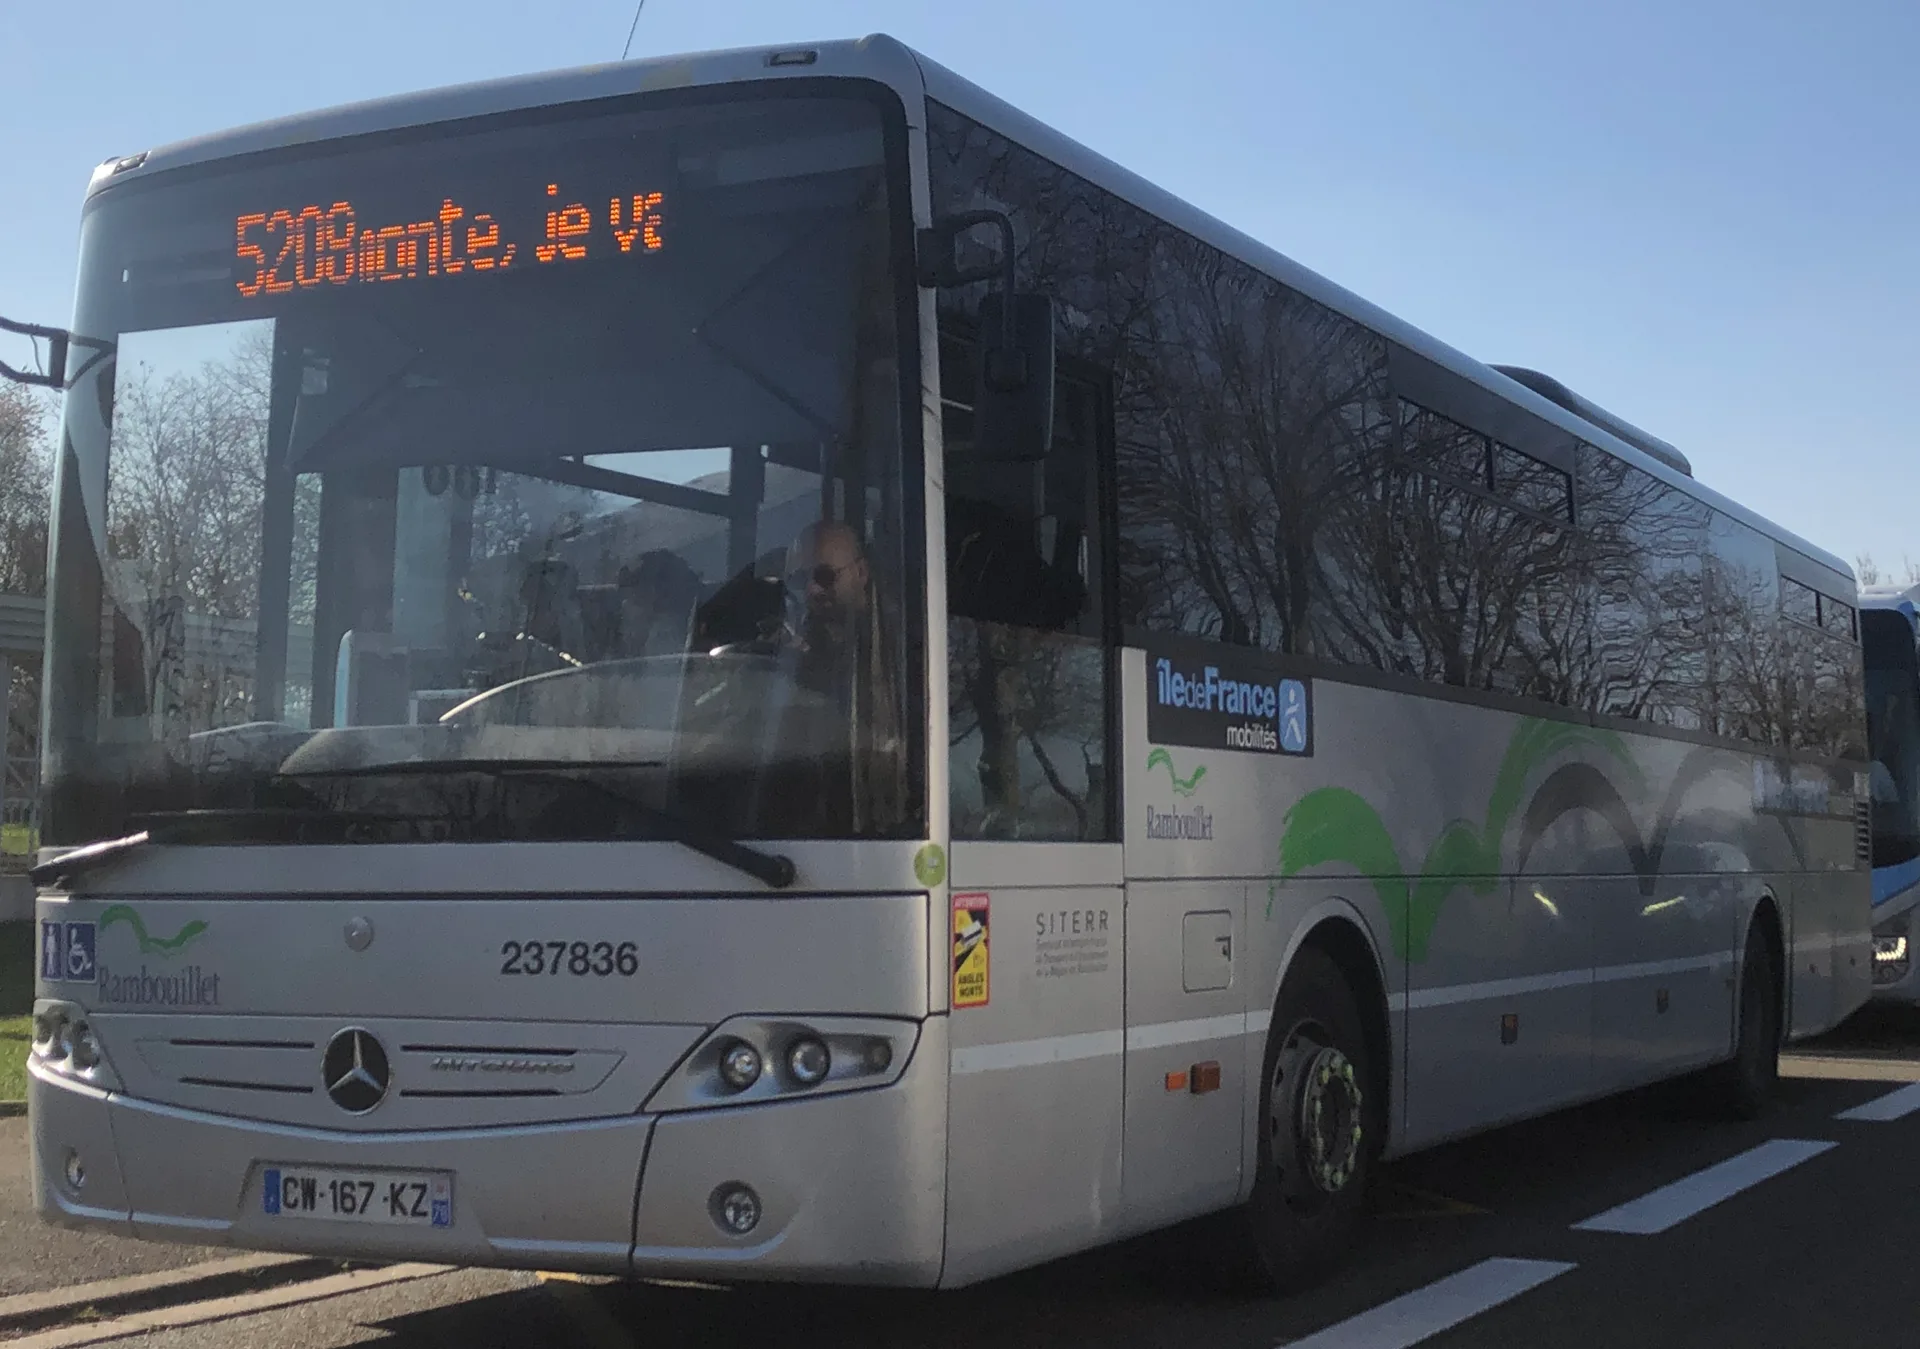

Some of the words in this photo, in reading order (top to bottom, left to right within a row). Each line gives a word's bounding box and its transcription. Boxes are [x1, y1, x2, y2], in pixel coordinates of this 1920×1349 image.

[536, 184, 591, 262] je
[1226, 721, 1277, 750] mobilités
[1146, 804, 1213, 840] Rambouillet
[1036, 909, 1109, 936] SITERR
[501, 940, 639, 976] 237836
[99, 965, 221, 1005] Rambouillet
